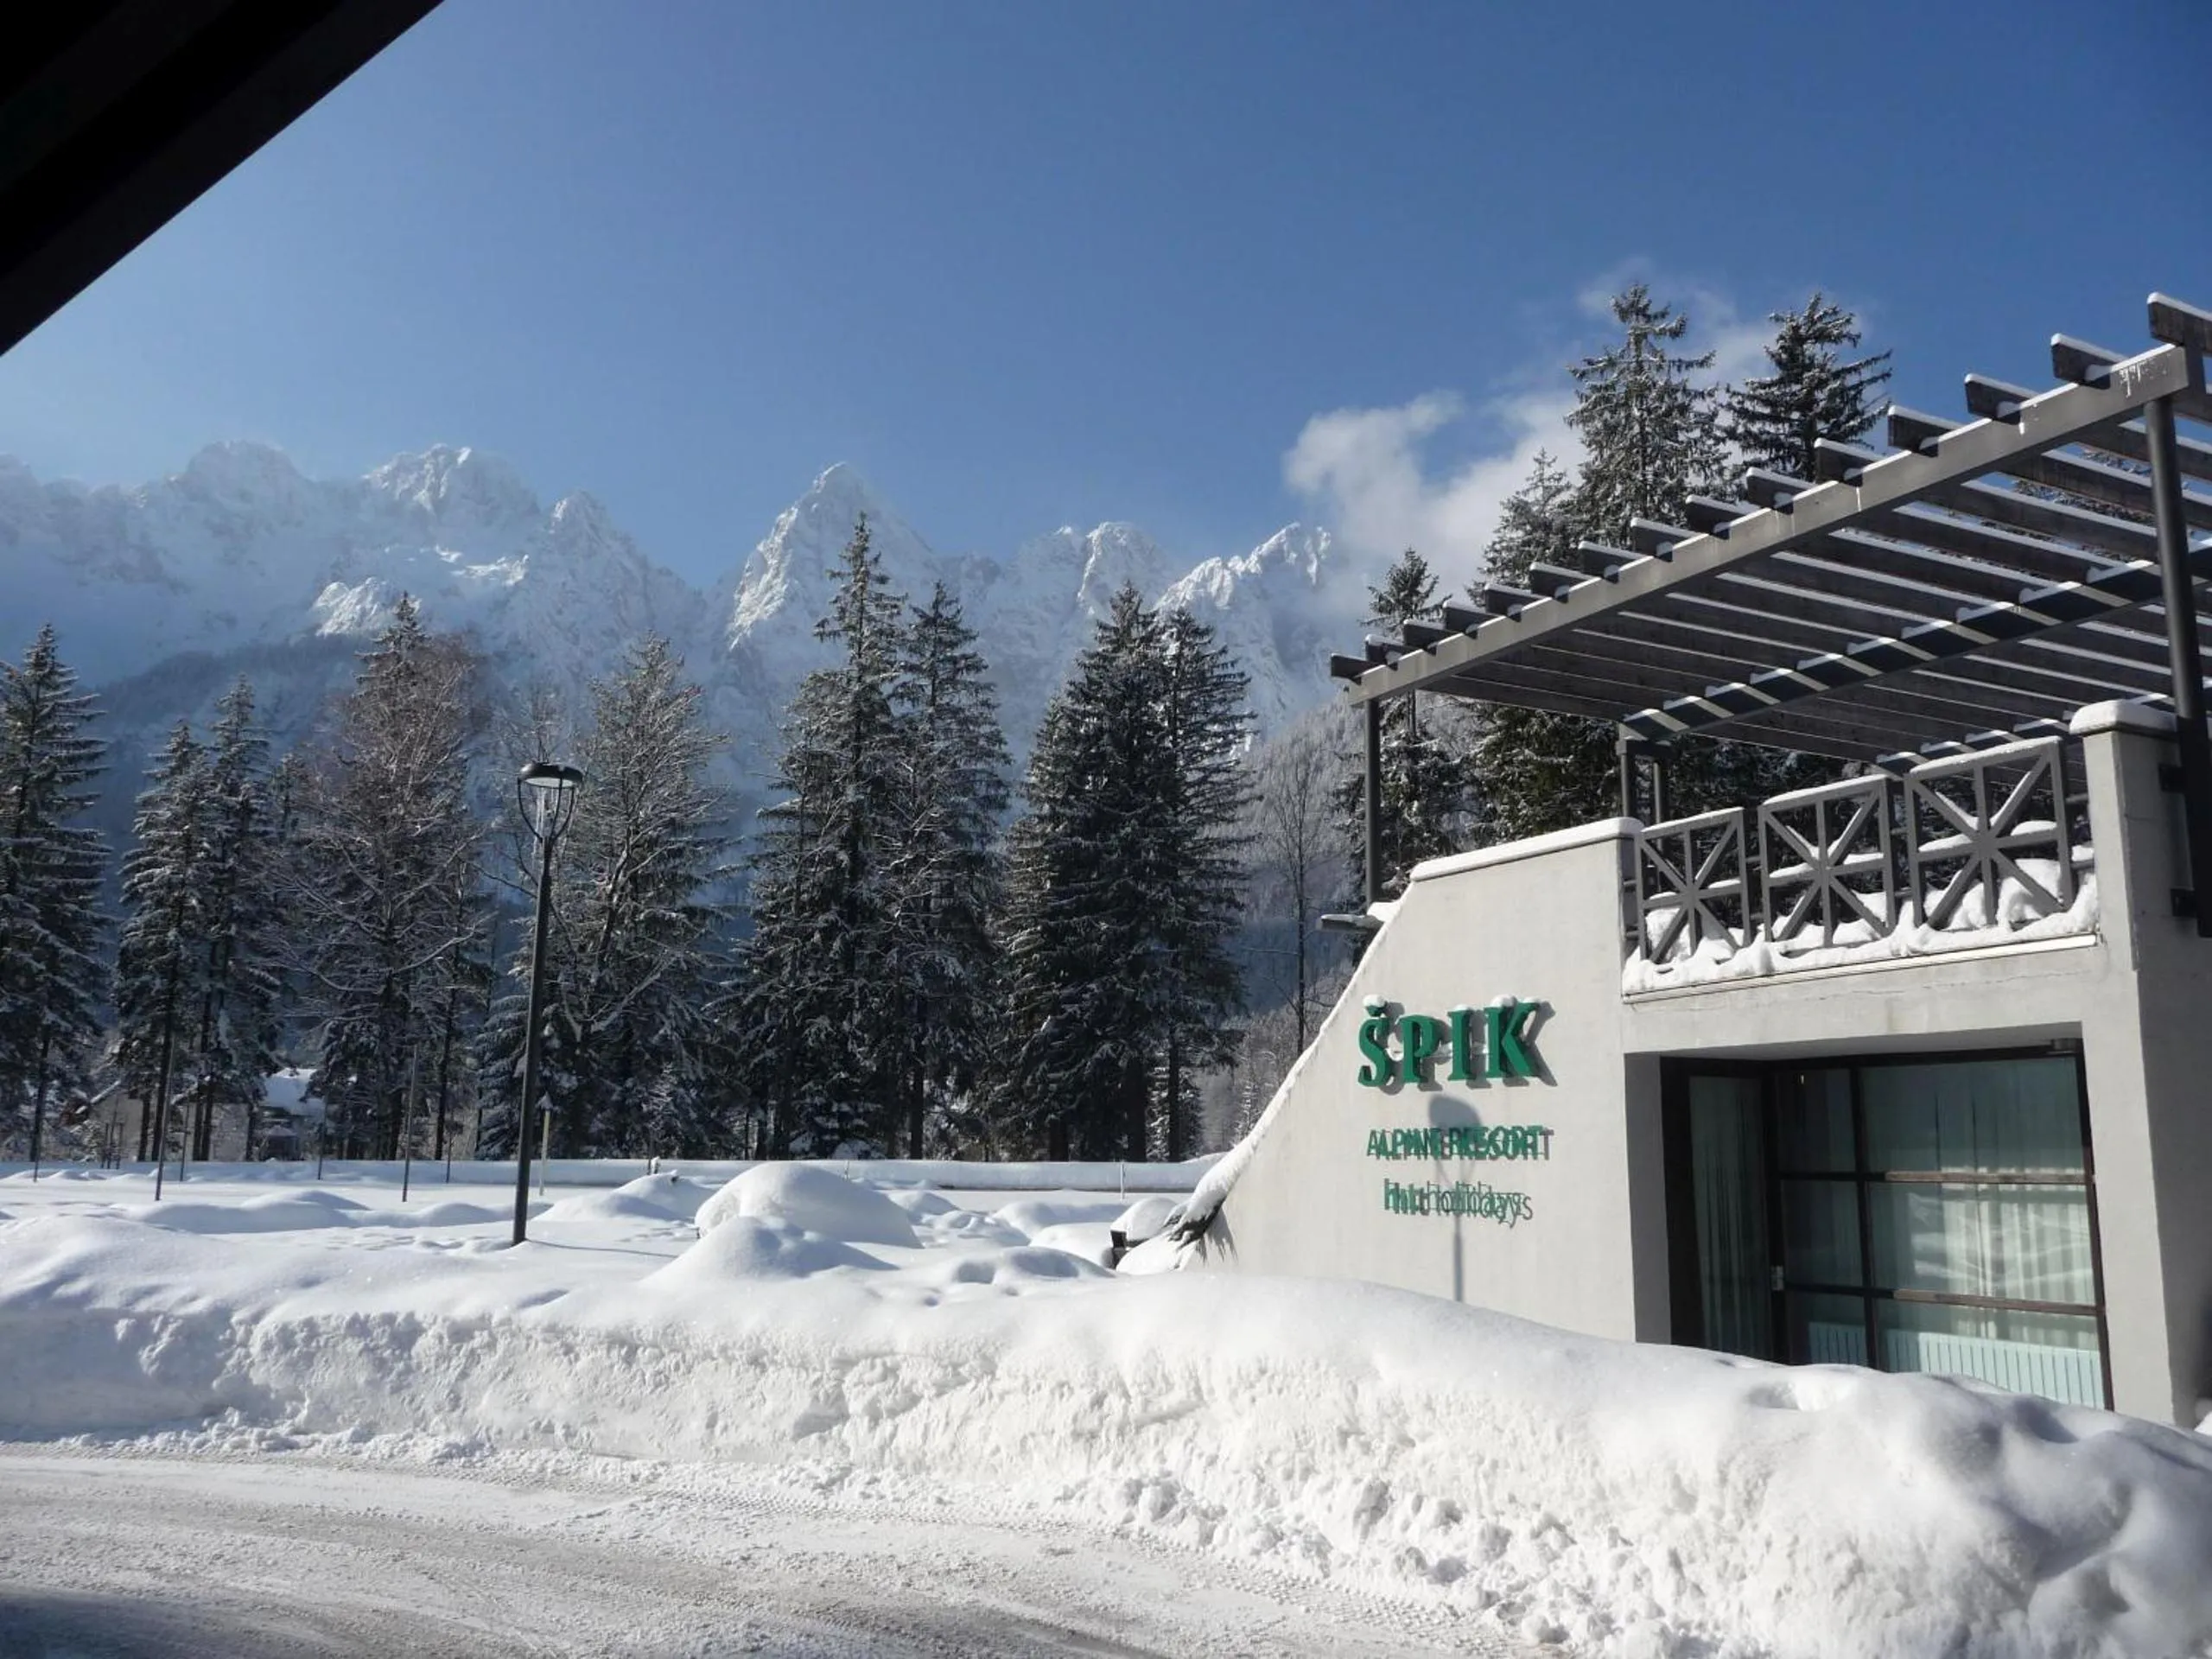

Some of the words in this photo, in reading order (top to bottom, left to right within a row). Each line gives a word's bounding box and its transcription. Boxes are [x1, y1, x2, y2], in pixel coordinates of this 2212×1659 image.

[1357, 1001, 1541, 1087] ŠPIK
[1366, 1127, 1445, 1157] ALPINE
[1449, 1125, 1545, 1157] RESORT
